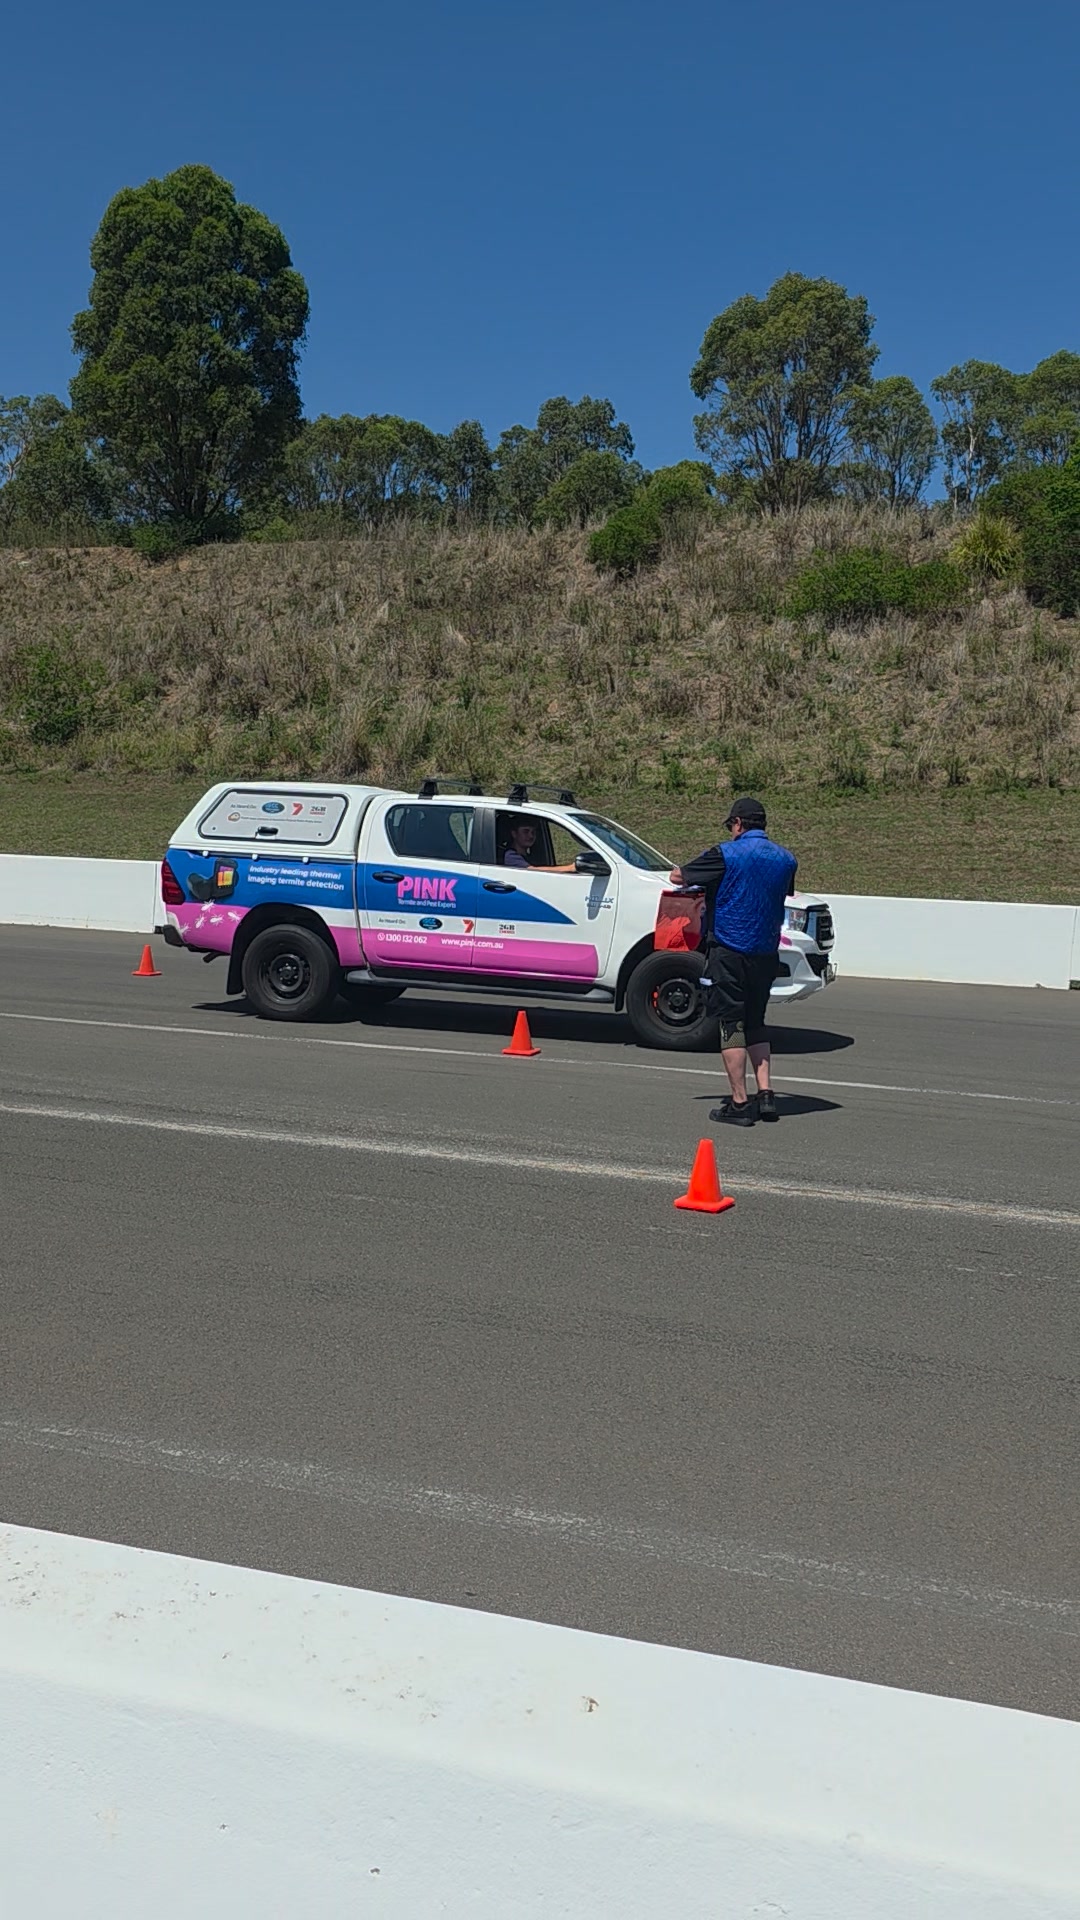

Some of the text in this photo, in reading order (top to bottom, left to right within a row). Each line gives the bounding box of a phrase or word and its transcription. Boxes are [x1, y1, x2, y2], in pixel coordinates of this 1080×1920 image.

[249, 865, 342, 880] Industry leading thermal
[278, 877, 305, 886] termite
[306, 879, 345, 891] detection
[397, 876, 458, 902] PINK
[385, 933, 428, 944] 1300 132 062
[441, 937, 504, 949] www.pink.com.au
